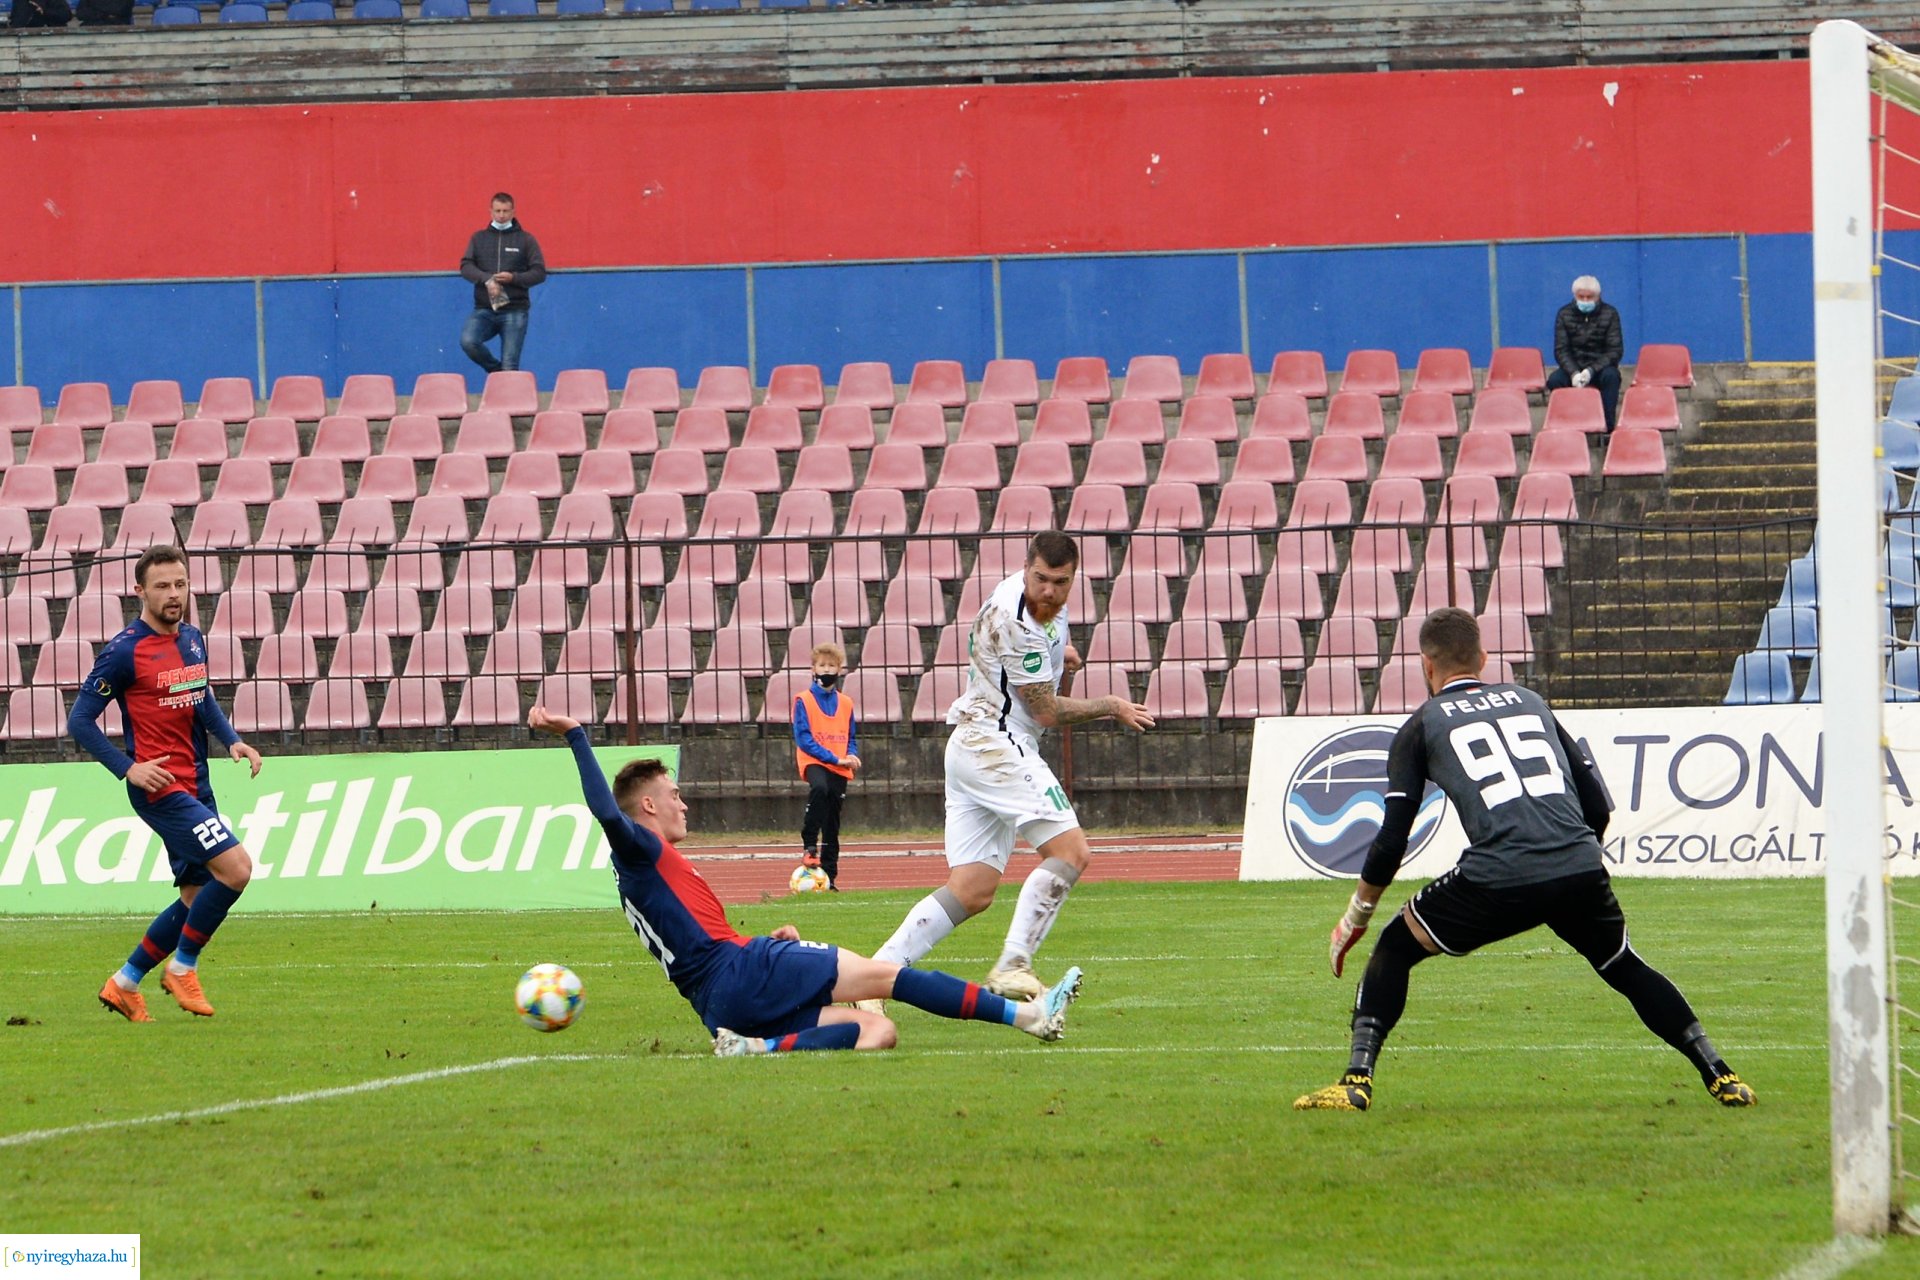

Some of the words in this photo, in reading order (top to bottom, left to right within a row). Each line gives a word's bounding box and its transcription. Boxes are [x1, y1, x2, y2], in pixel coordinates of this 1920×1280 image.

[1440, 690, 1523, 717] FEJÉR
[1449, 714, 1566, 810] 95
[1044, 785, 1071, 811] 16
[0, 776, 612, 886] katilban
[192, 817, 229, 850] 22
[1636, 824, 1903, 864] SZOLGÁLTÓ
